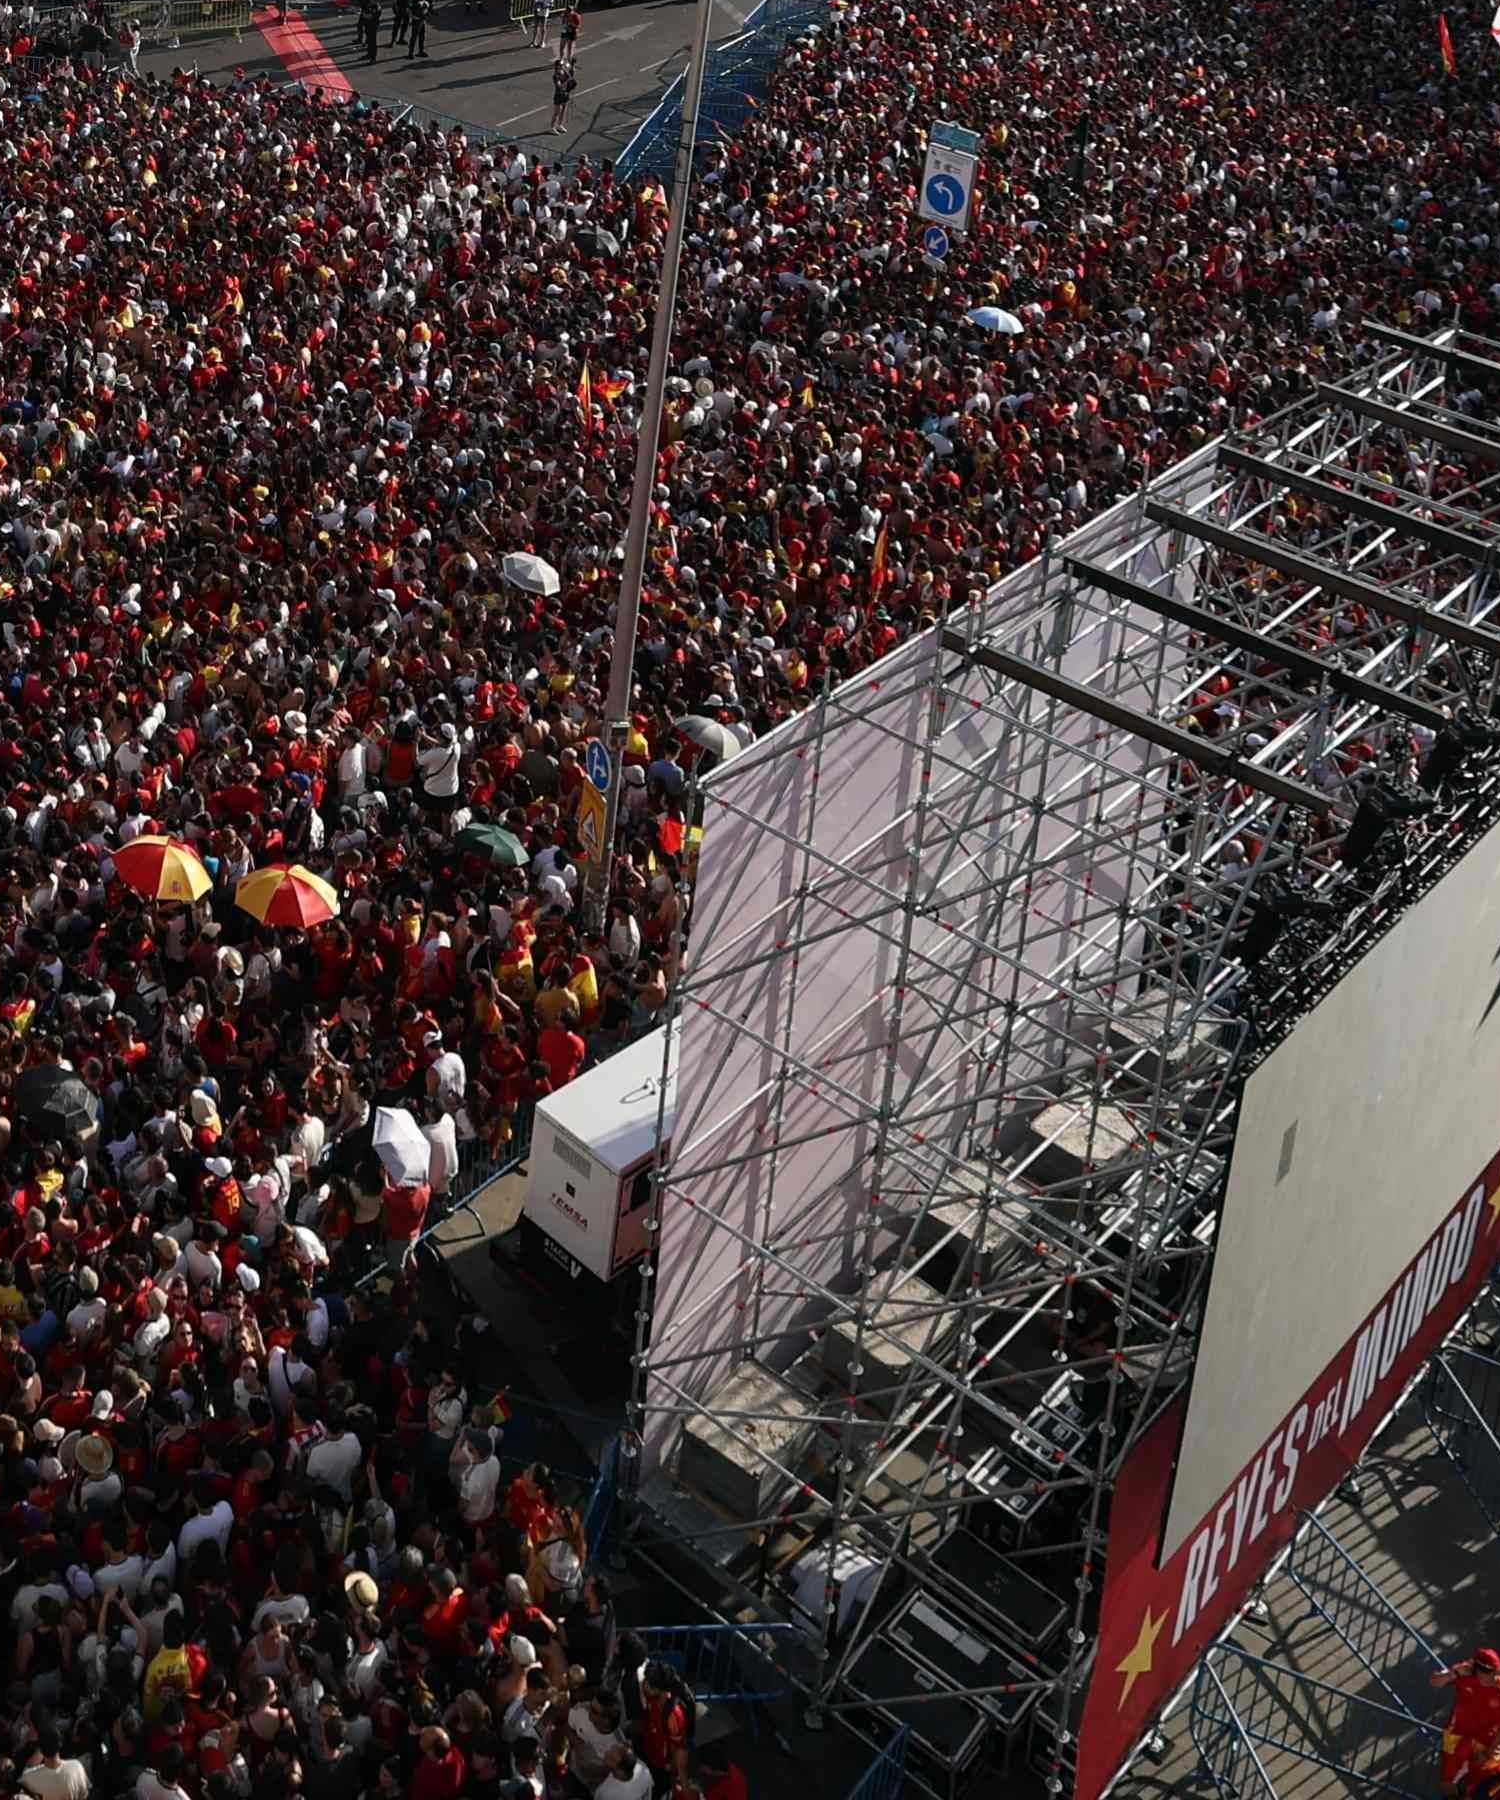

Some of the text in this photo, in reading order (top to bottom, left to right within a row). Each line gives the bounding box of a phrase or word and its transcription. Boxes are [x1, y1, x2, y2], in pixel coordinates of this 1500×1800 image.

[570, 1259, 583, 1279] V
[1171, 1182, 1485, 1648] REYES DEL MUNDO
